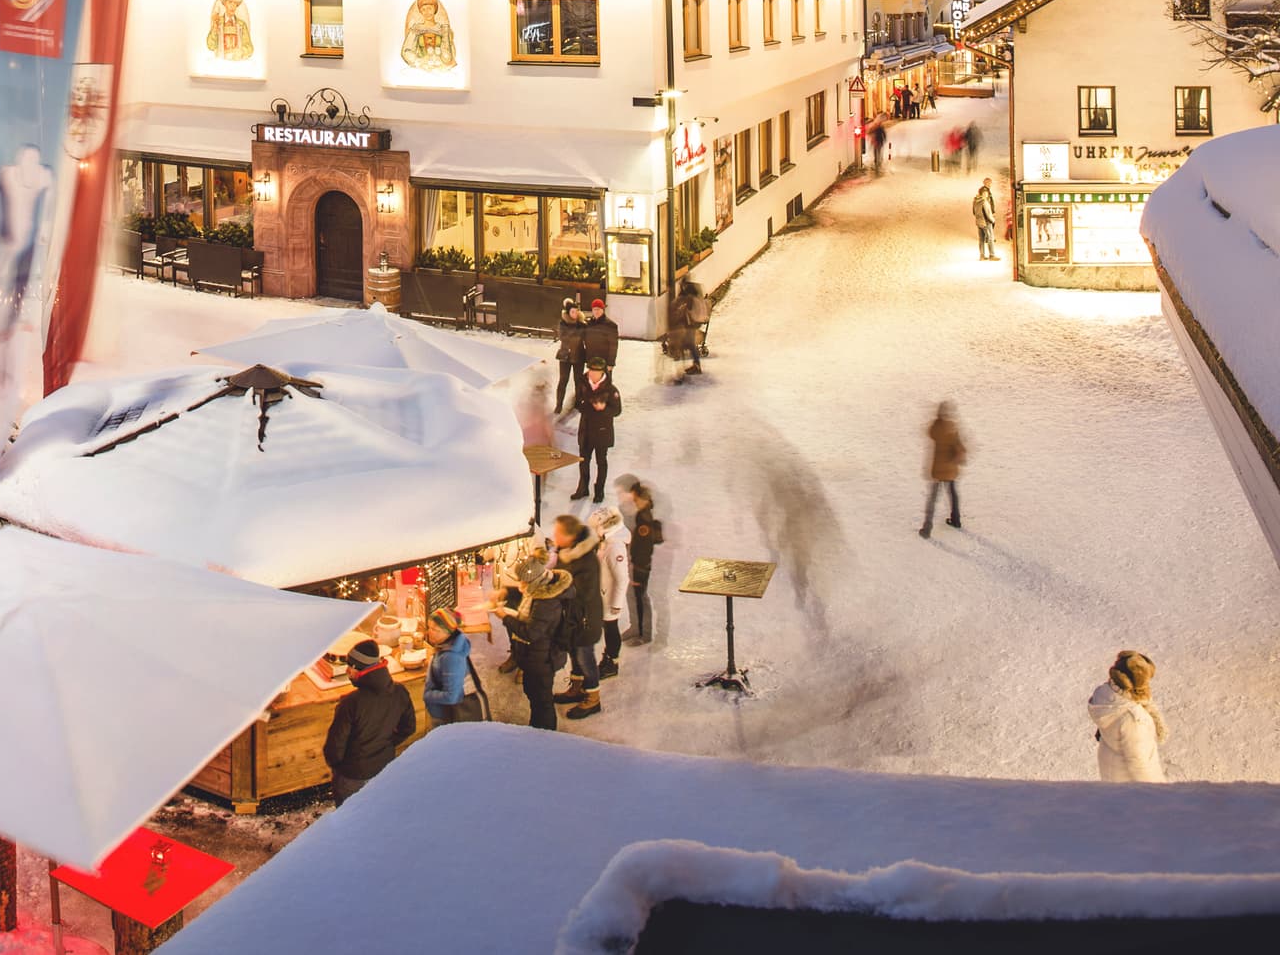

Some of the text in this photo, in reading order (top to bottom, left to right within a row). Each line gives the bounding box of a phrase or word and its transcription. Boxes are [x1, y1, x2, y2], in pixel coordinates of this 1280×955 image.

[263, 126, 371, 148] RESTAURANT
[1073, 146, 1134, 159] UHREN
[1040, 193, 1093, 203] UHREN
